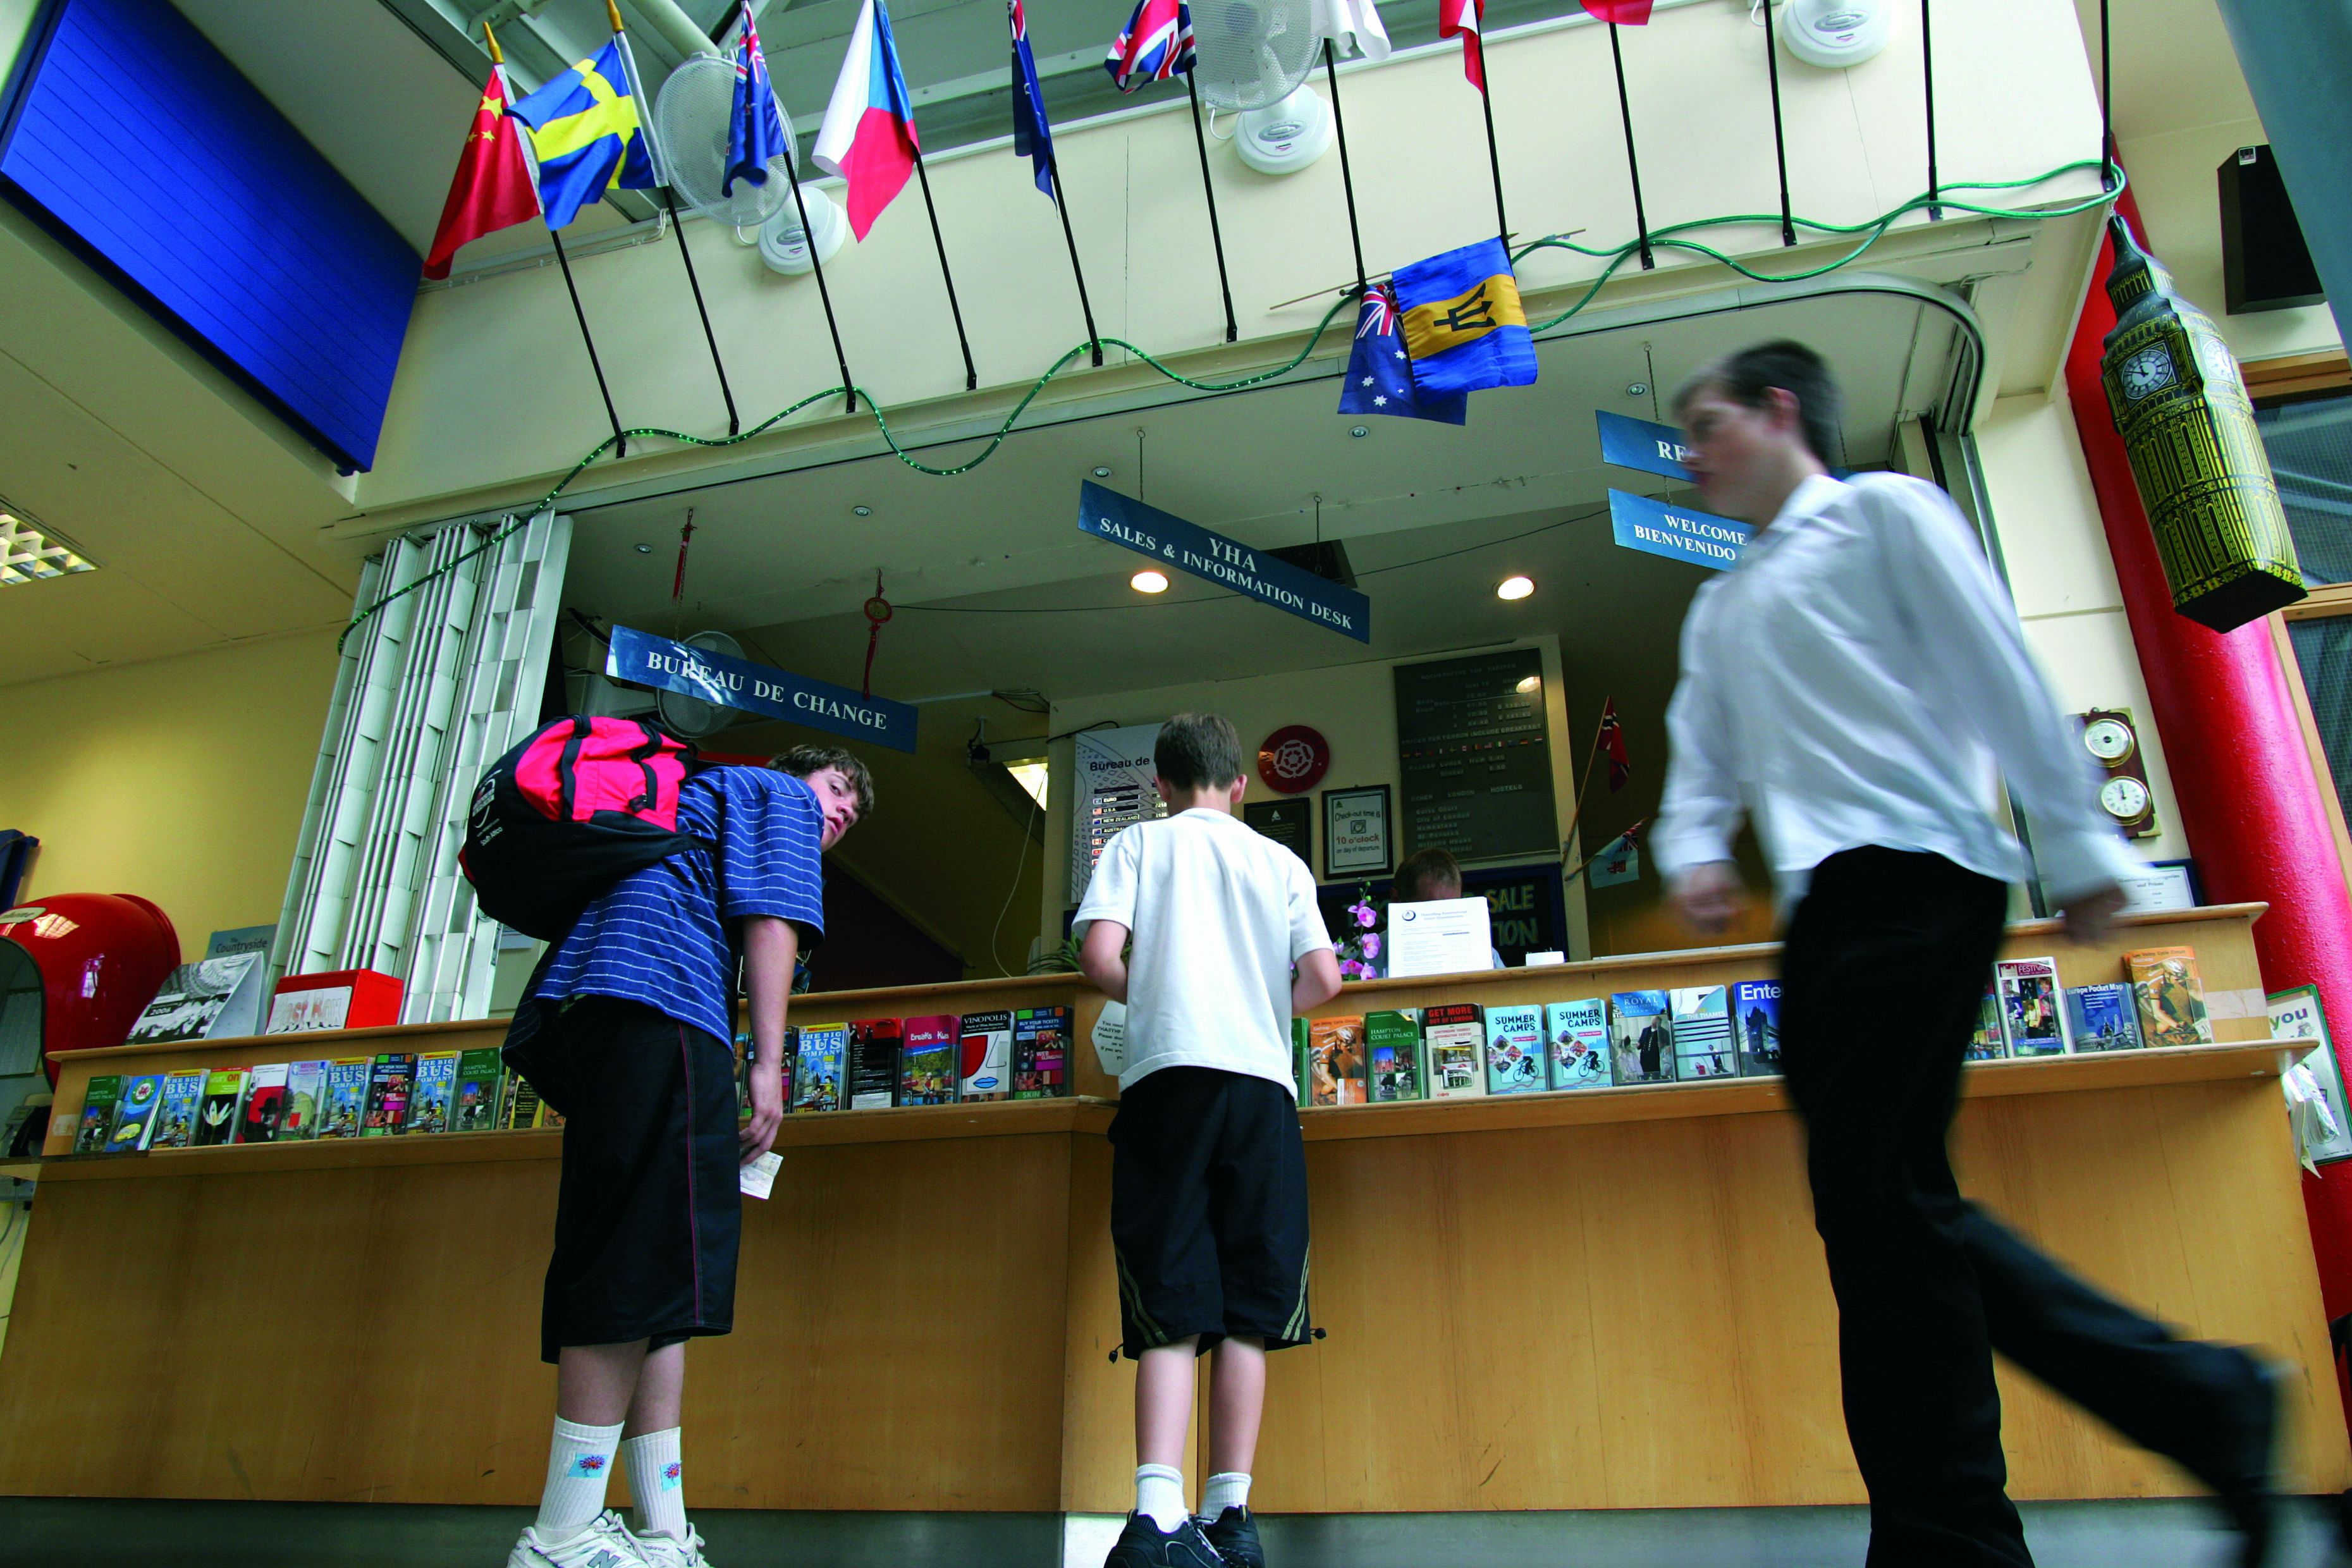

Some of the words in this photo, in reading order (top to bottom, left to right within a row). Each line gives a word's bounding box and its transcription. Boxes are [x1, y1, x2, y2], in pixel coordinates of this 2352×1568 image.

[1664, 514, 1747, 546] WELCOME
[1634, 525, 1736, 561] BIENVENIDO
[1208, 537, 1257, 572] YHA
[1100, 518, 1156, 550] SALES
[1164, 544, 1175, 558] &
[1184, 551, 1303, 609] INFORMATION
[1311, 602, 1352, 630] DESK
[646, 651, 744, 691] BUREAU
[753, 680, 784, 702] DE
[793, 692, 886, 730] CHANGE
[1442, 732, 1469, 740] PERSON
[1470, 728, 1500, 737] INCLUDE
[1501, 723, 1541, 732] BREAKFAST
[1090, 759, 1131, 771] Bureau
[1136, 757, 1149, 766] de
[1490, 784, 1523, 792] HOSTELS
[1335, 811, 1361, 821] Check-out
[1443, 812, 1471, 821] London
[1336, 836, 1346, 844] 10
[1349, 833, 1379, 843] o'clock
[1485, 885, 1534, 914] SALE
[216, 938, 267, 953] Countryside
[2018, 965, 2050, 973] FESTIVAL
[1741, 984, 1782, 1001] Ente
[2067, 987, 2088, 995] Europe
[1624, 996, 1658, 1006] ROYAL
[1429, 1008, 1447, 1017] GET
[1448, 1006, 1473, 1015] MORE
[1559, 1009, 1601, 1020] SUMMER
[964, 1014, 1007, 1024] VINOPOLIS
[1495, 1014, 1536, 1025] SUMMER
[1567, 1017, 1600, 1028] CAMPS
[2269, 1008, 2308, 1031] you
[1504, 1023, 1535, 1032] CAMPS
[799, 1038, 842, 1052] BUS
[417, 1065, 453, 1077] BUS
[329, 1071, 365, 1083] BUS
[166, 1083, 199, 1094] BUS
